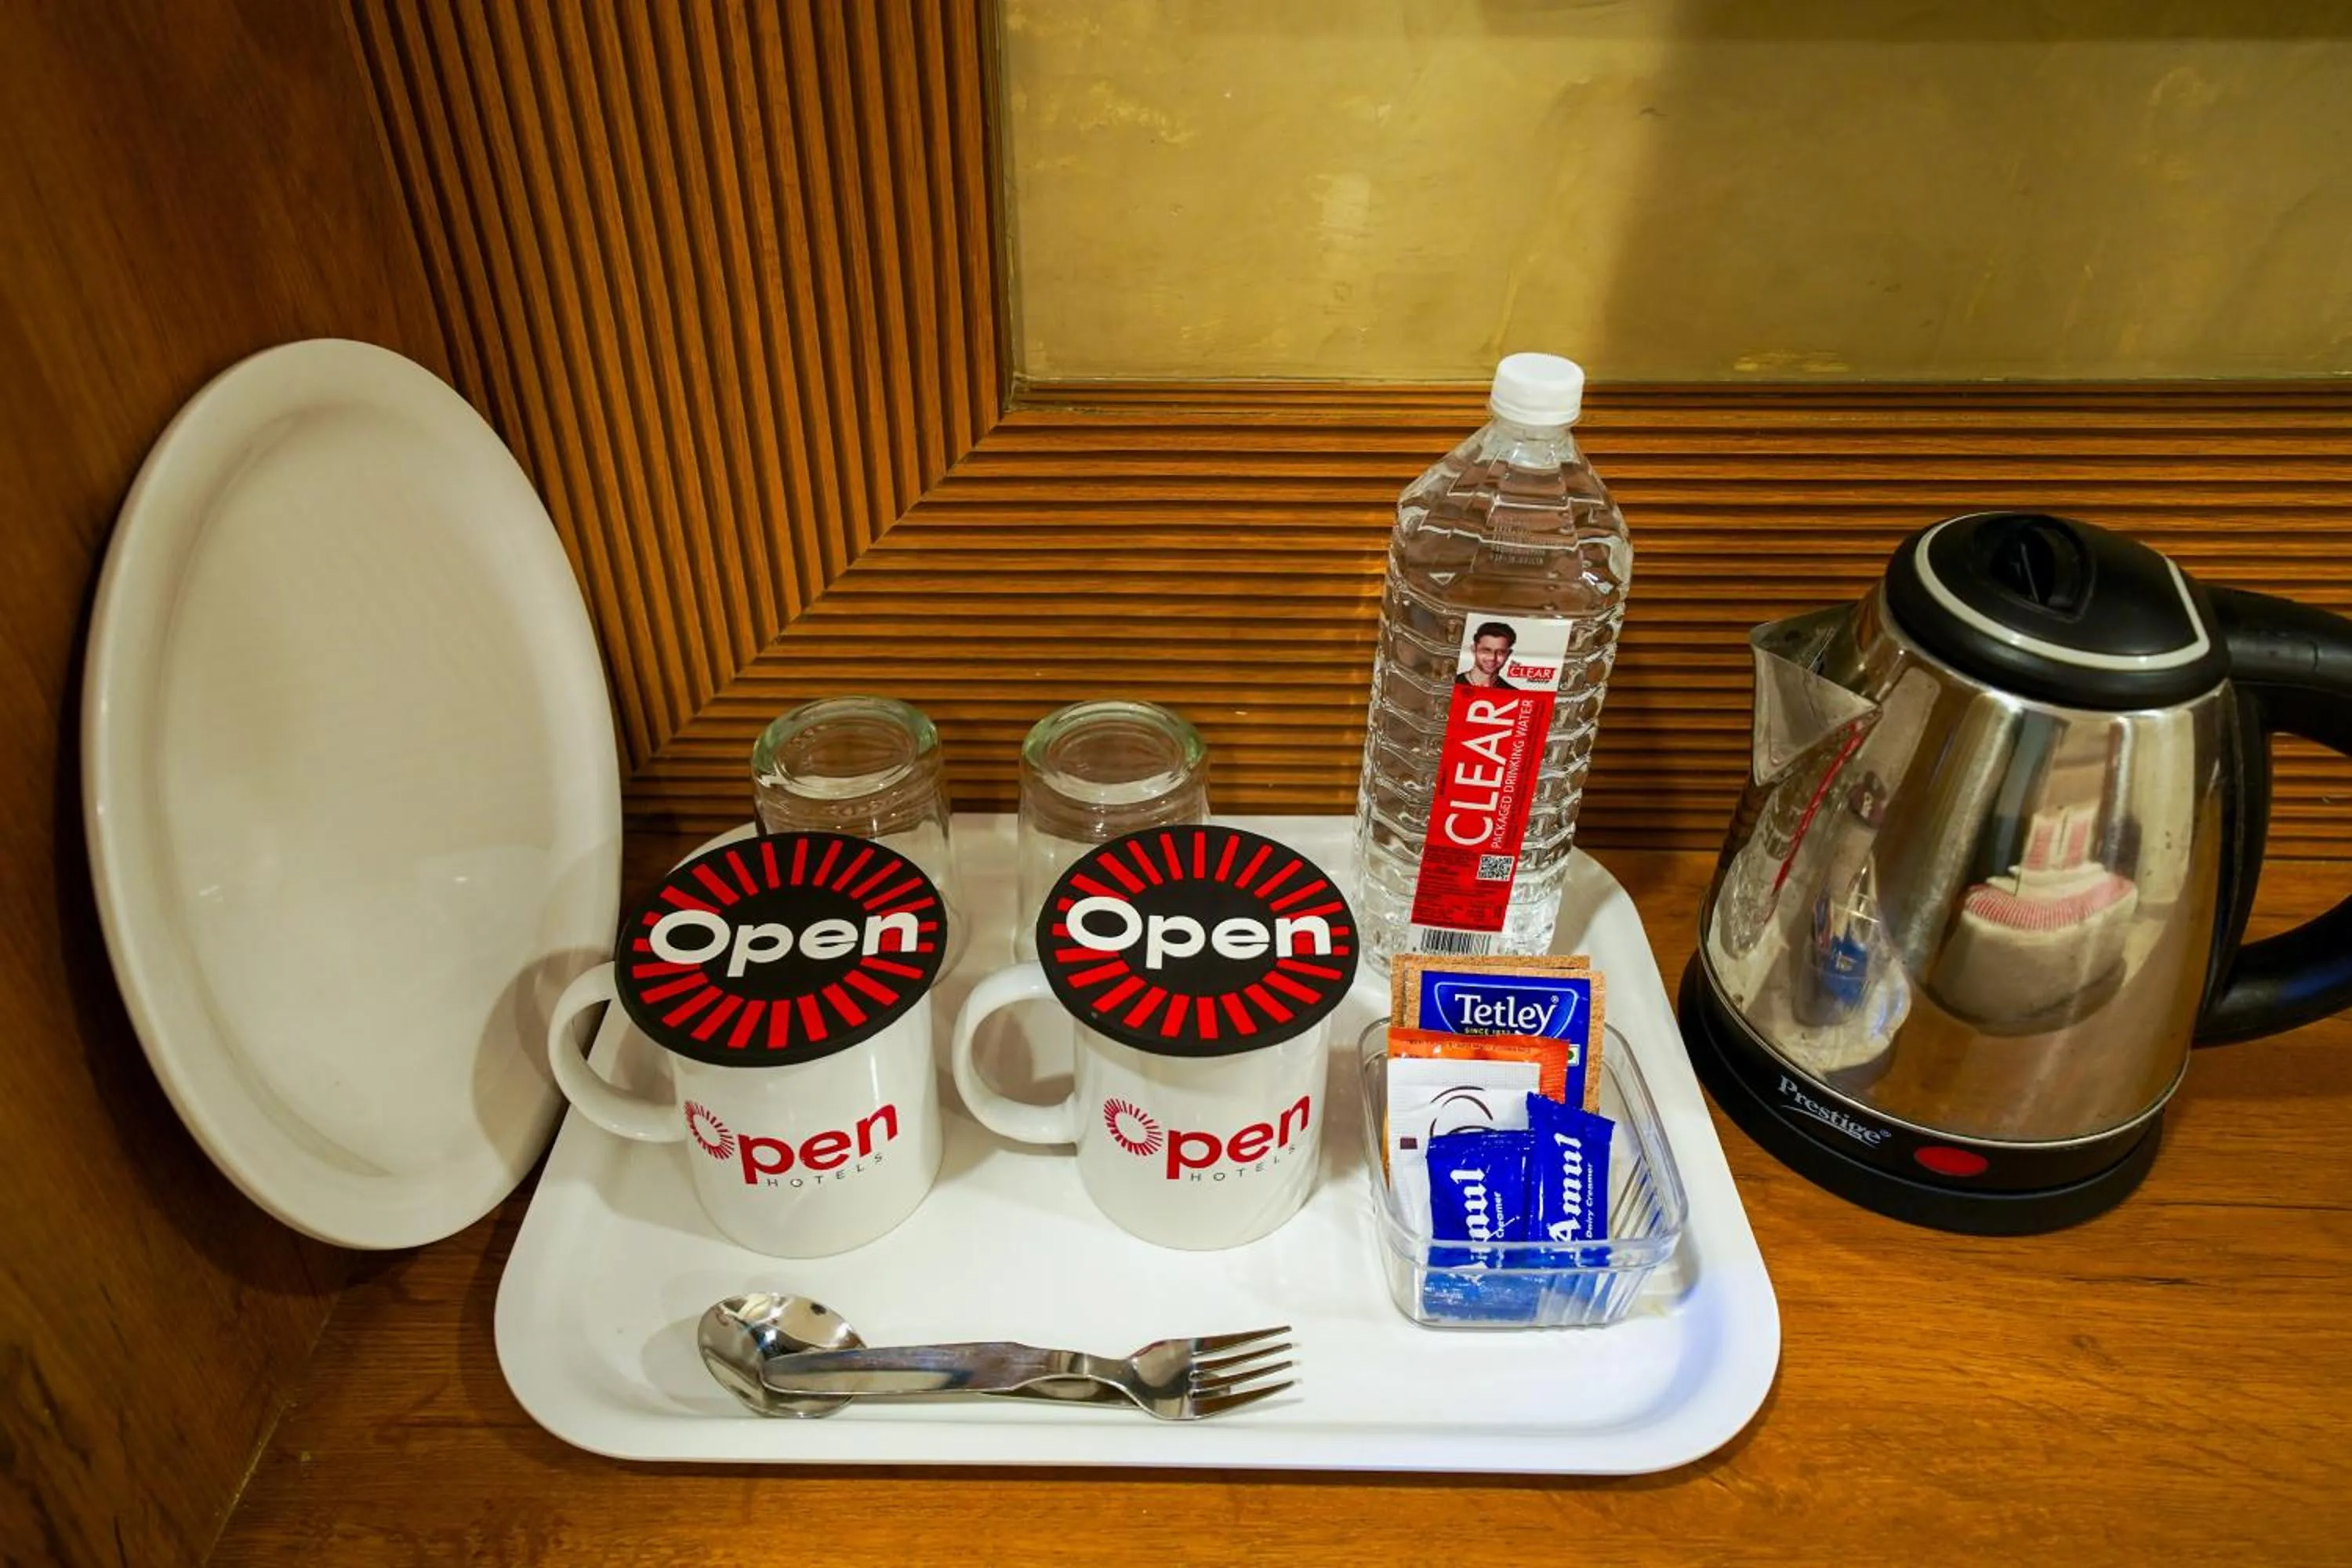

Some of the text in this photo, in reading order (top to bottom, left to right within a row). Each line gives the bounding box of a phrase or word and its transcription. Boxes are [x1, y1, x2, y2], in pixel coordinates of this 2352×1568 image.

[1509, 667, 1552, 678] CLEAR
[1443, 698, 1519, 847] CLEAR
[1491, 796, 1512, 849] PACKAGED
[1503, 739, 1525, 793] DRINKING
[1516, 699, 1534, 738] WATER
[649, 909, 919, 978] Open
[1065, 895, 1332, 970] Open
[1454, 993, 1558, 1036] Tetley
[684, 1099, 898, 1185] Open
[1104, 1095, 1311, 1179] Open
[1777, 1075, 1882, 1145] Prestige
[767, 1153, 885, 1188] HOTELS
[1190, 1145, 1297, 1181] HOTELS
[1494, 1191, 1504, 1239] Creamer
[1585, 1207, 1595, 1239] Dairy
